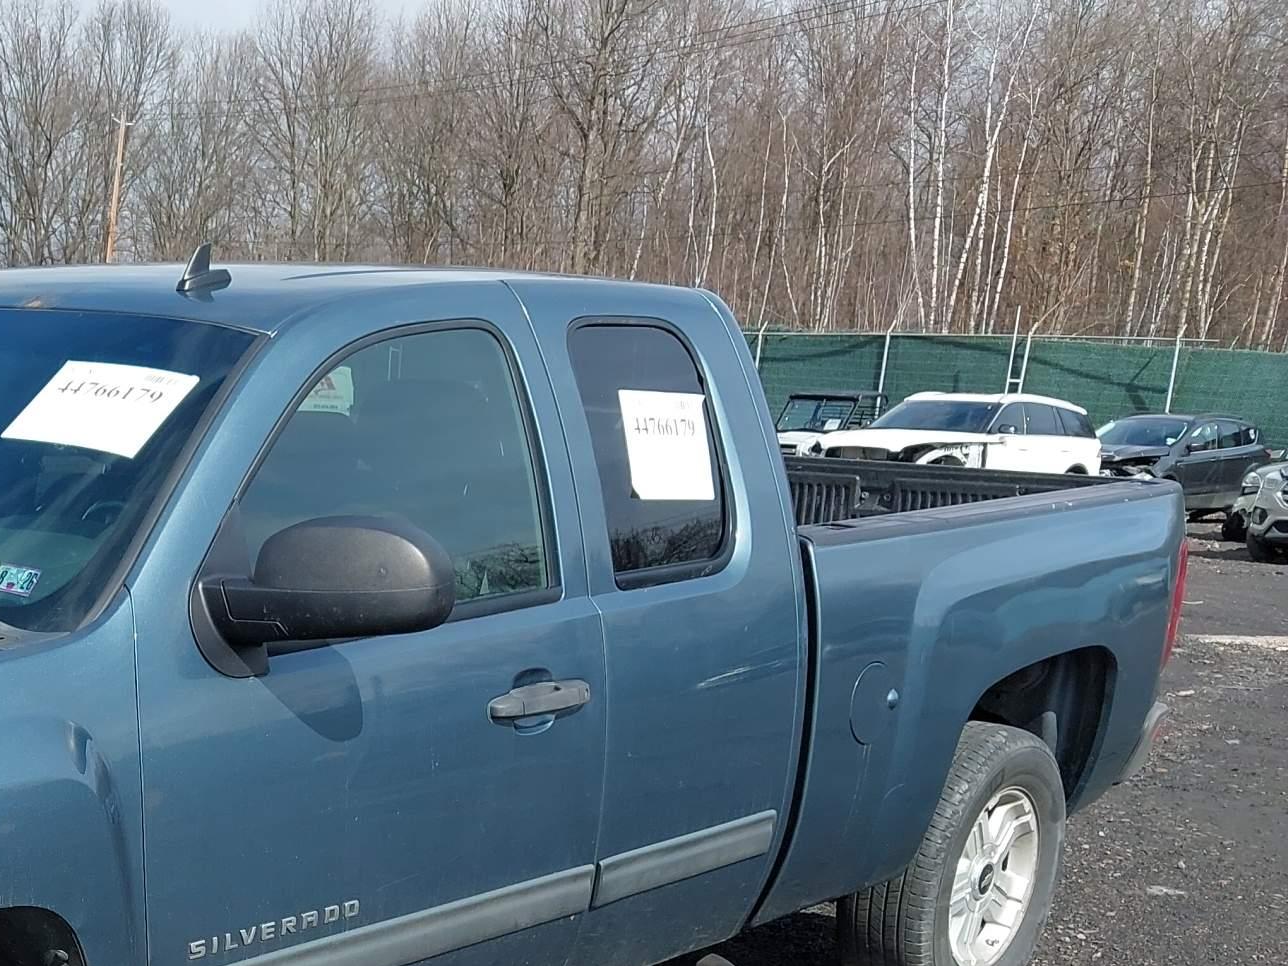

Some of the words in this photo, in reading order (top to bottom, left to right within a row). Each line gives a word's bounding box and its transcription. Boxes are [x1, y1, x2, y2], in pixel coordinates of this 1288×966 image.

[57, 380, 164, 403] 44766179
[633, 416, 696, 437] 44766179
[189, 899, 360, 960] SILVERADO
